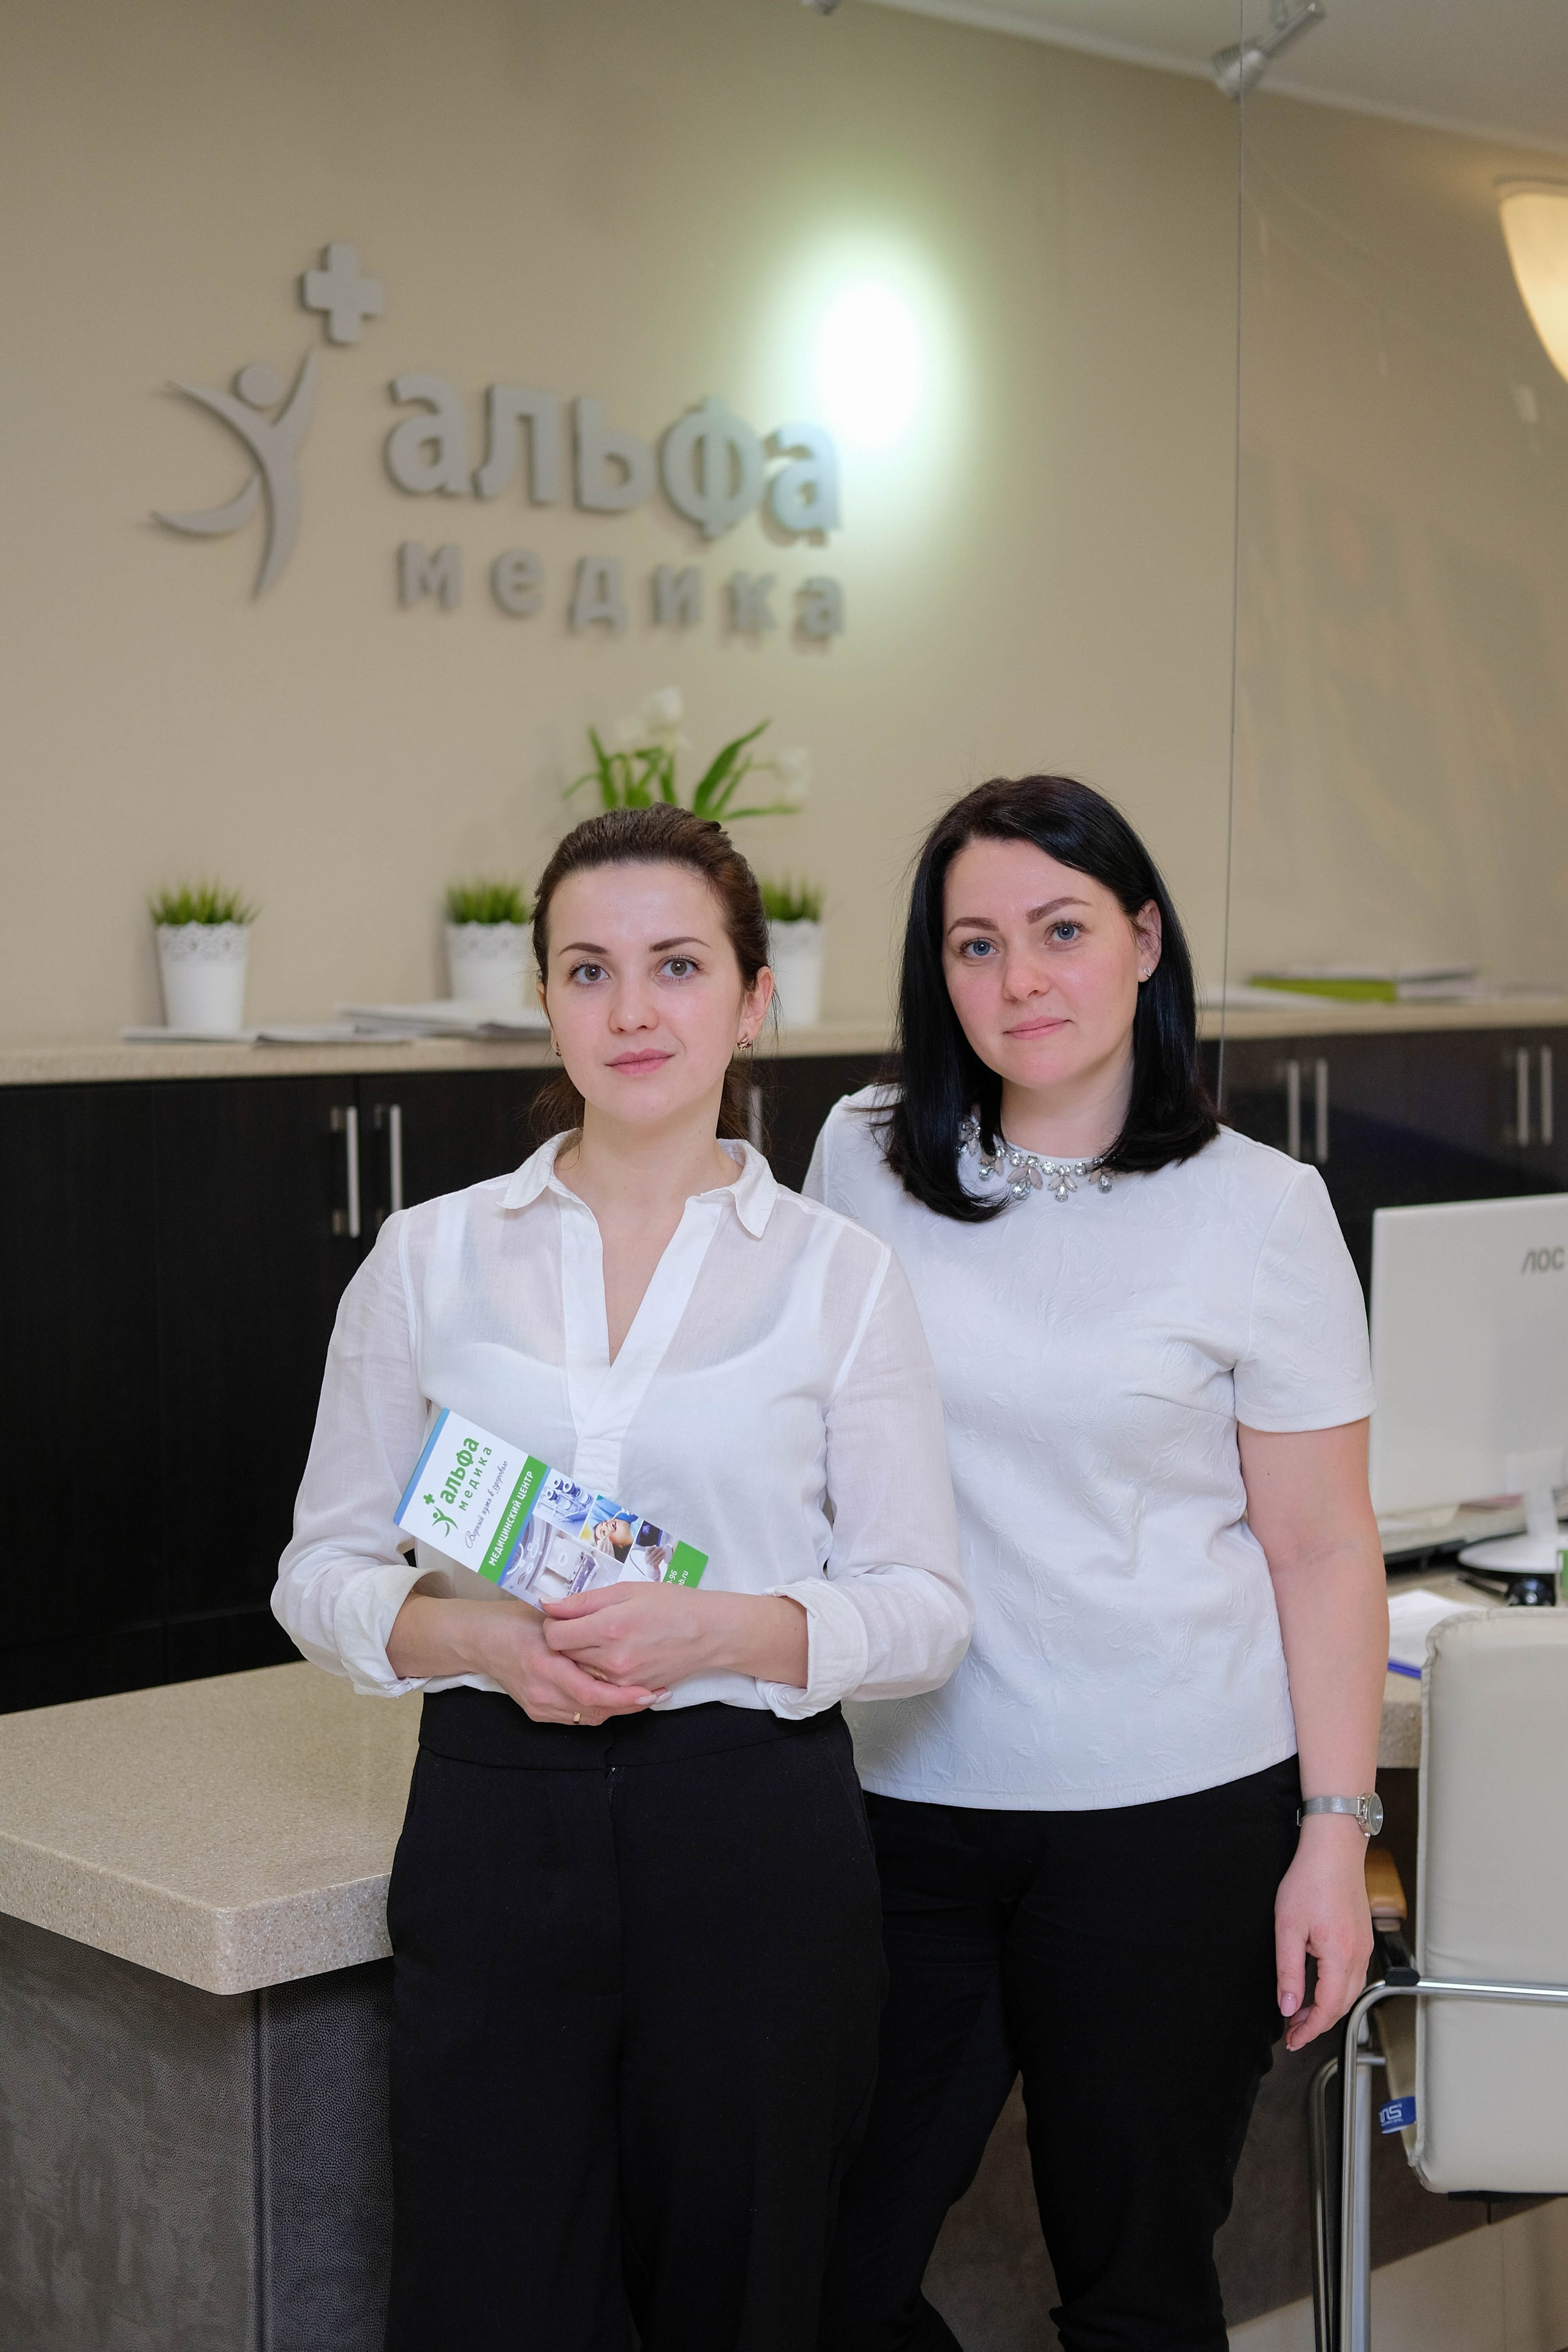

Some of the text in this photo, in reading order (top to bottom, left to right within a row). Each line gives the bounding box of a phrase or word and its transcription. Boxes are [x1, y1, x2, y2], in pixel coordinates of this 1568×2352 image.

[399, 540, 845, 636] медика
[459, 1447, 492, 1511] медика
[465, 1515, 484, 1549] Верный
[481, 1498, 492, 1514] путь
[492, 1460, 508, 1494] здоровью
[488, 1471, 534, 1567] МЕДИЦИНСКИЙ ЦЕНТР
